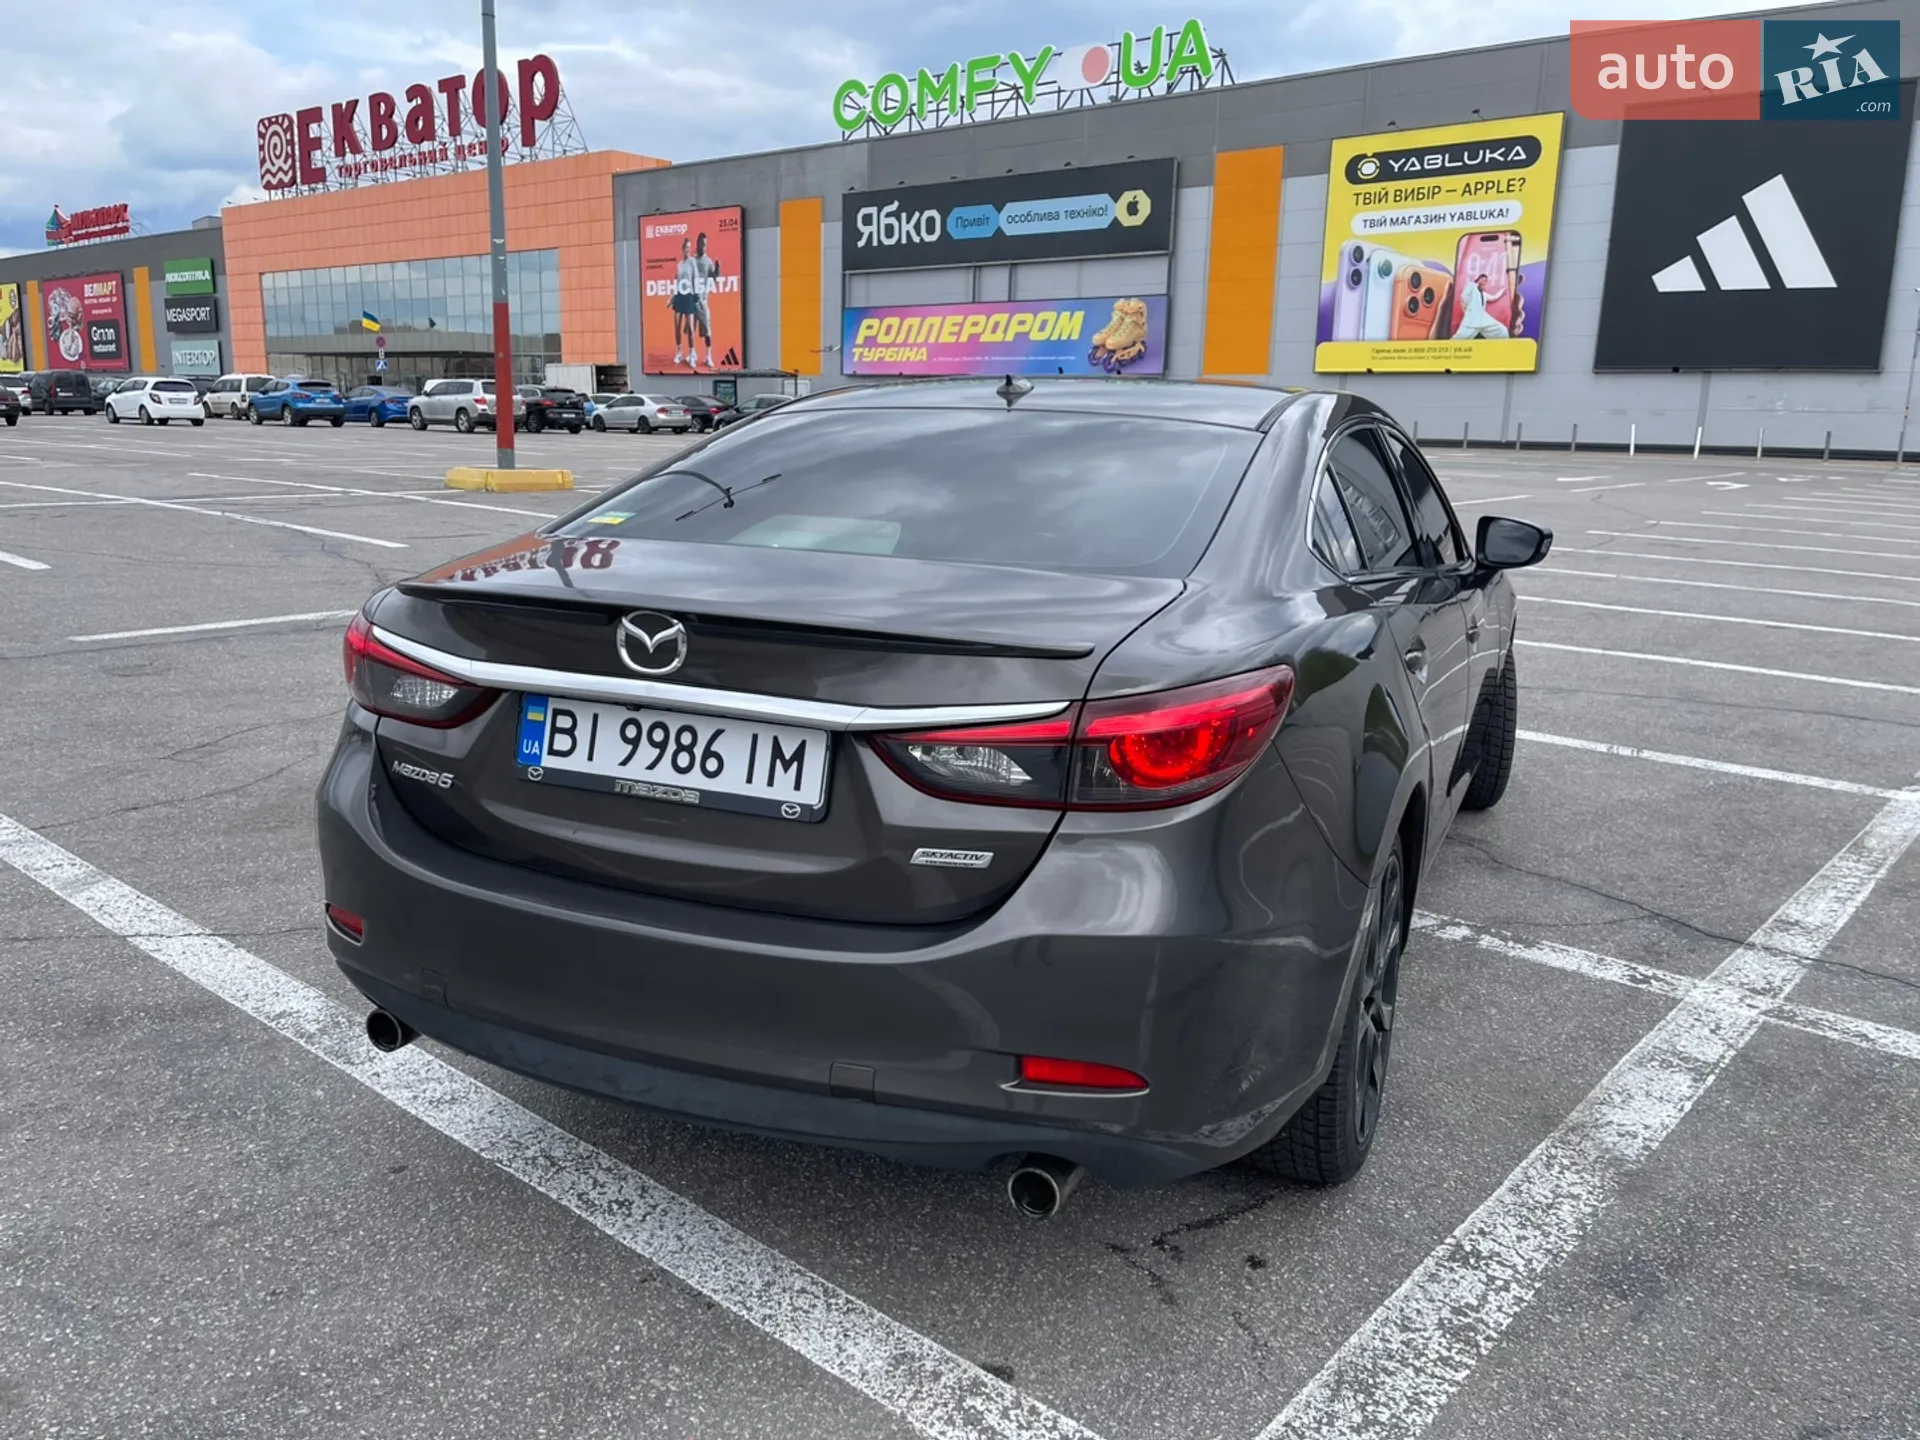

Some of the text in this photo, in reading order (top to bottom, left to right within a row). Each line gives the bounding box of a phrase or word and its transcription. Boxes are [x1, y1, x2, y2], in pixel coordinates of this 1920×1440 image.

[833, 17, 1215, 132] COMFY UA
[454, 136, 510, 162] ценр
[1388, 145, 1527, 173] YABLUKA
[1353, 187, 1390, 207] ТВІЙ
[1393, 184, 1442, 204] ВИБІР
[1461, 177, 1527, 197] APPLE?
[856, 199, 942, 249] Ябко
[955, 203, 1109, 231] Привіт особлива техніко!
[1362, 207, 1510, 230] ТВІЙ МАГАЗИН YABLUKA!
[166, 307, 211, 322] MEGASPORT
[855, 310, 1085, 345] РОЛЛЕРДРОМ
[852, 346, 928, 363] ТУРБІНА
[522, 738, 541, 756] UA
[547, 707, 808, 792] BI 9986 IM
[920, 851, 985, 861] SKYACTIV
